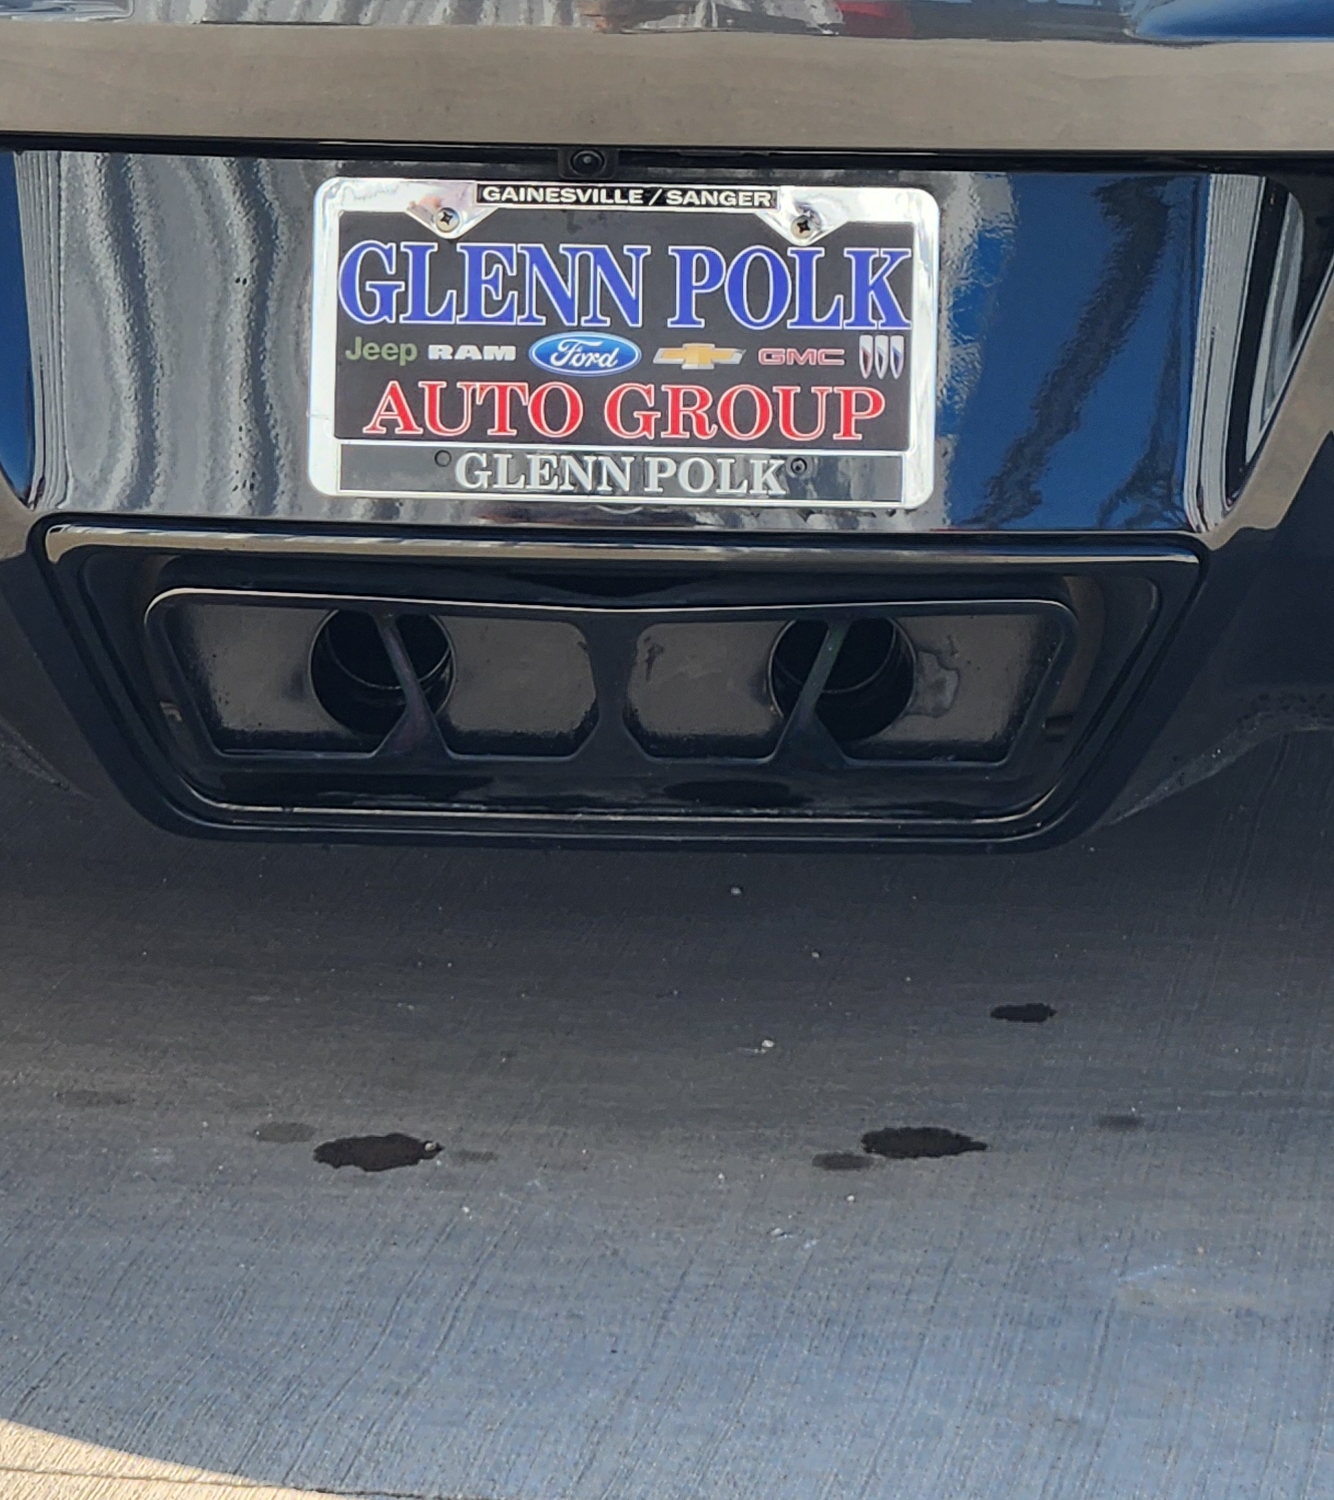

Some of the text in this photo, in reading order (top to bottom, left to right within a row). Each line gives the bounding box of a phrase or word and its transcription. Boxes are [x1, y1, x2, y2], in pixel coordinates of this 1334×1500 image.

[481, 185, 644, 205] GAINESVILLE
[666, 189, 773, 208] SANGER
[338, 239, 913, 331] GLENN POLK
[345, 337, 846, 368] Jeep RAM Ford GMC
[362, 379, 886, 442] AUTO GROUP
[454, 451, 787, 497] GLENN POLK
